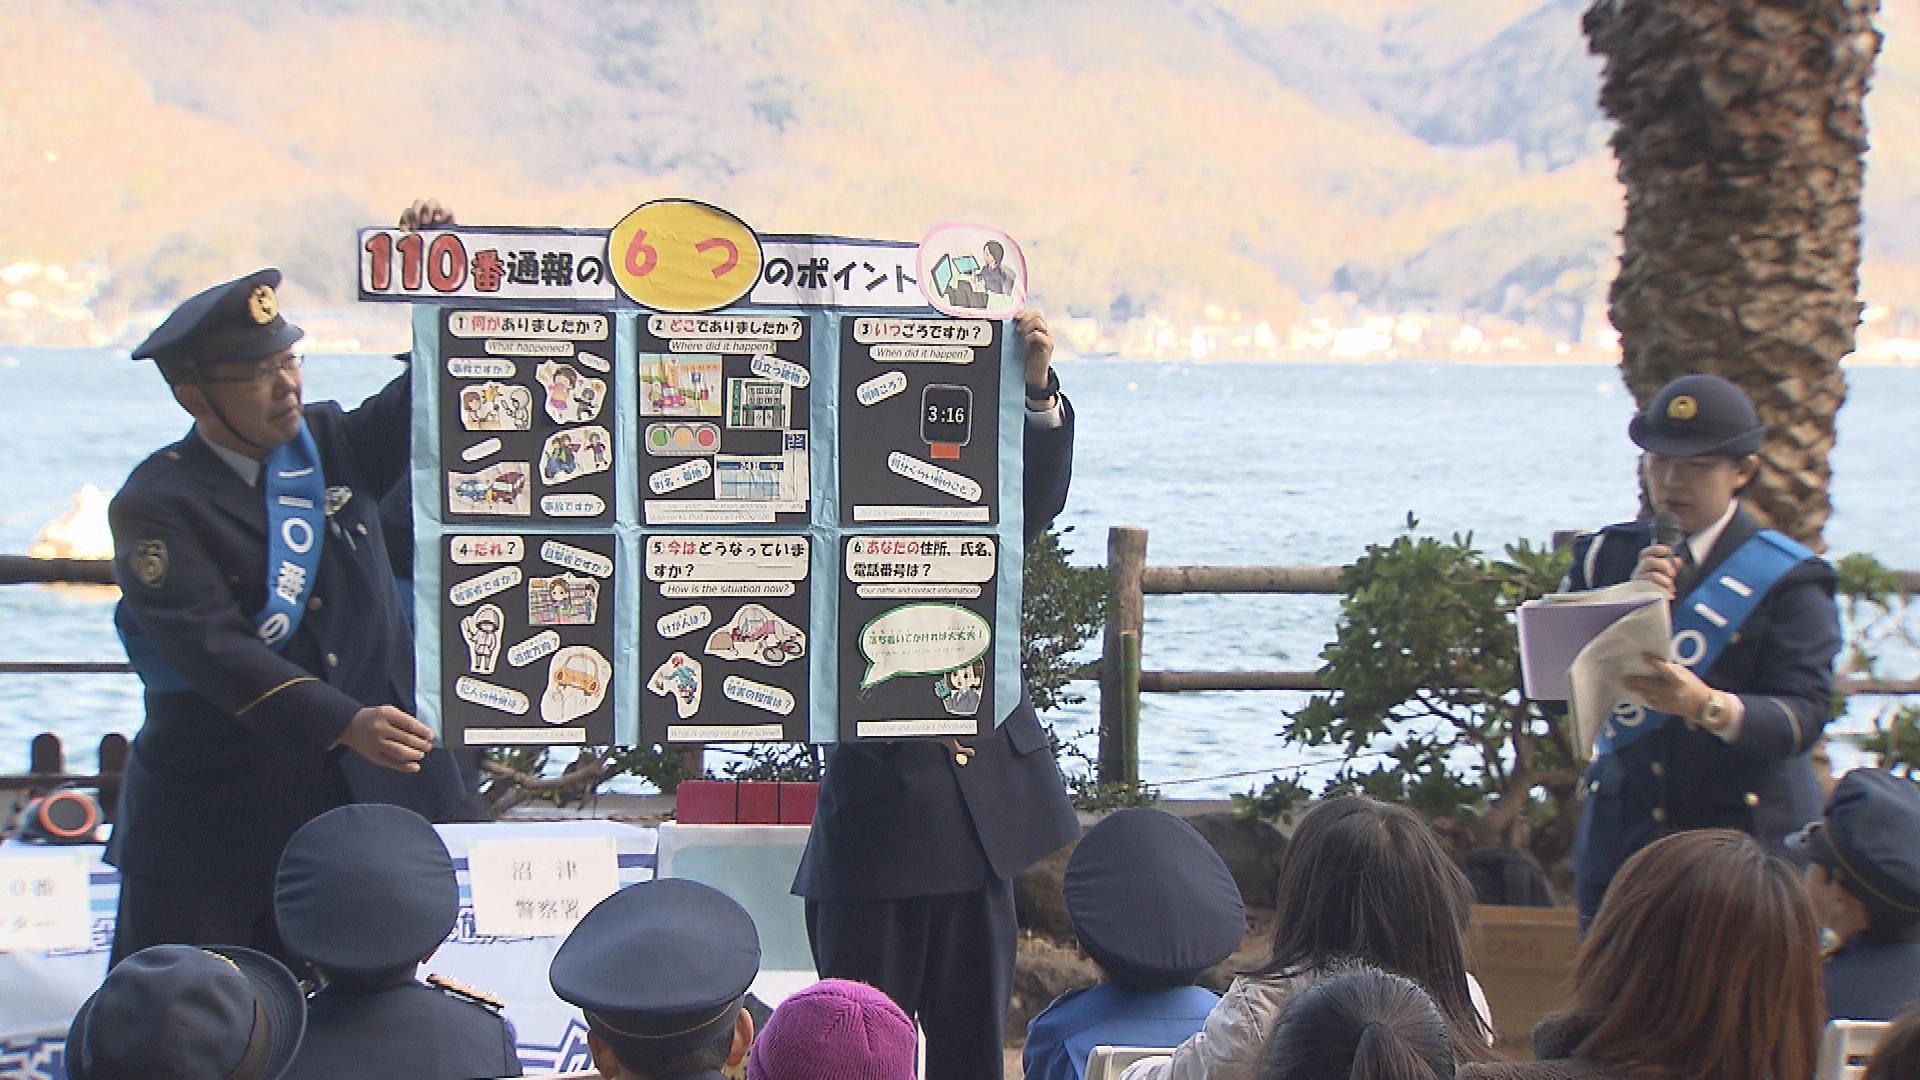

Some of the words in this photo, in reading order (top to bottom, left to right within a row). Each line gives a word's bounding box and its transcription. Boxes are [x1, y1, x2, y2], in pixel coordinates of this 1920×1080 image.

[366, 233, 604, 293] 110番通報の
[764, 256, 917, 294] のポイント
[671, 341, 704, 352] Where
[706, 342, 721, 352] did
[732, 342, 775, 354] happen?
[877, 347, 902, 358] When
[904, 348, 919, 358] did
[929, 349, 969, 361] happen?
[928, 405, 966, 423] 3:16
[653, 563, 695, 579] すか？
[853, 562, 932, 579] 電話番号は？
[667, 583, 689, 593] How
[702, 583, 718, 593] the
[720, 583, 761, 593] situation
[763, 584, 789, 593] now?
[514, 898, 580, 920] 警察署
